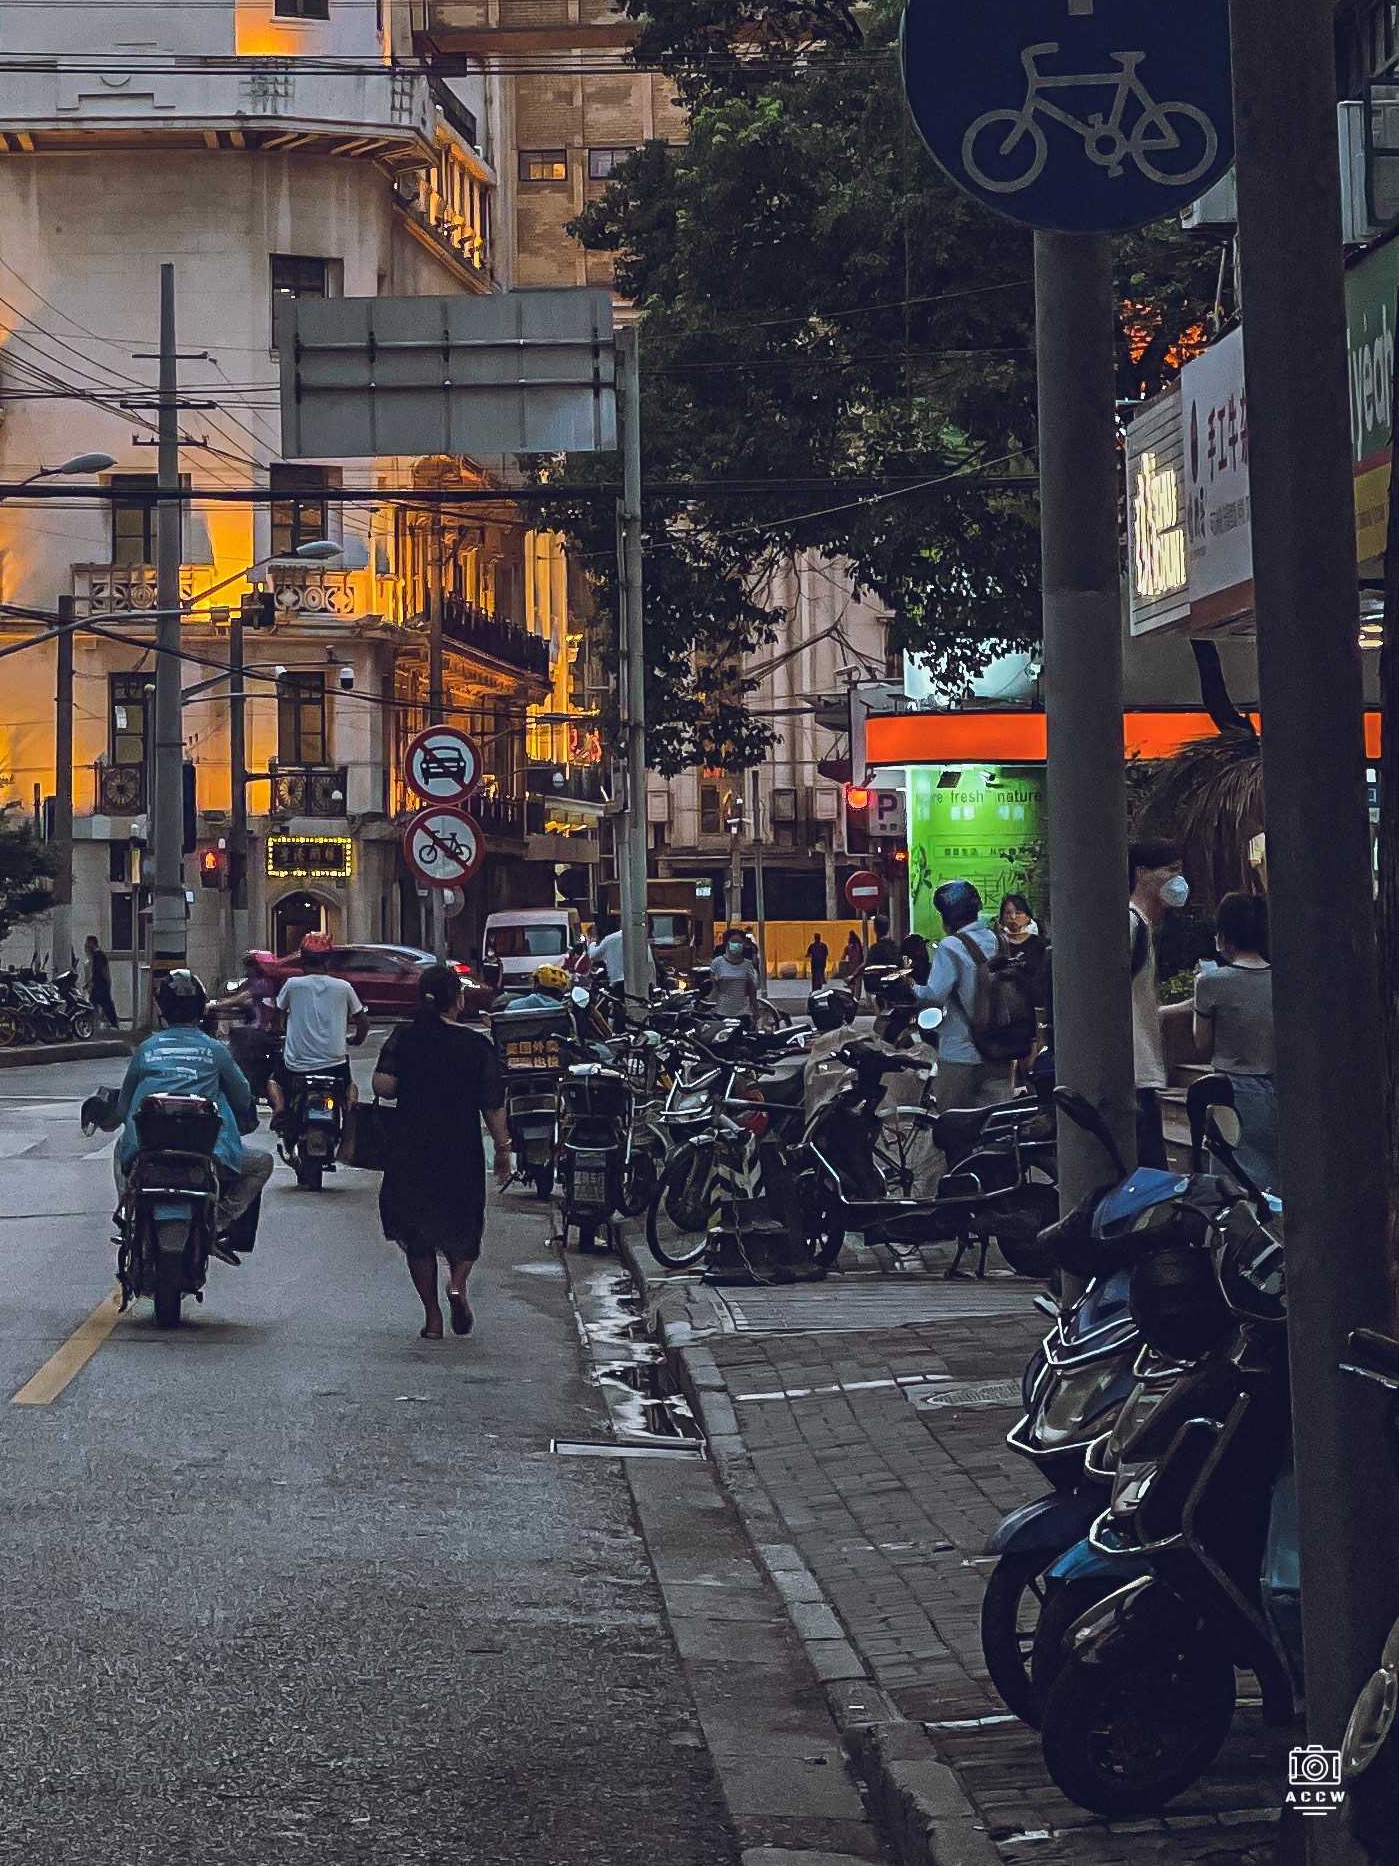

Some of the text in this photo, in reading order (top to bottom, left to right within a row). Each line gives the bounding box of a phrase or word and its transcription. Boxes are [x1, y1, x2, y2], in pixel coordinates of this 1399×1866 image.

[950, 789, 984, 804] fresh
[997, 789, 1042, 804] nature
[878, 794, 898, 820] P
